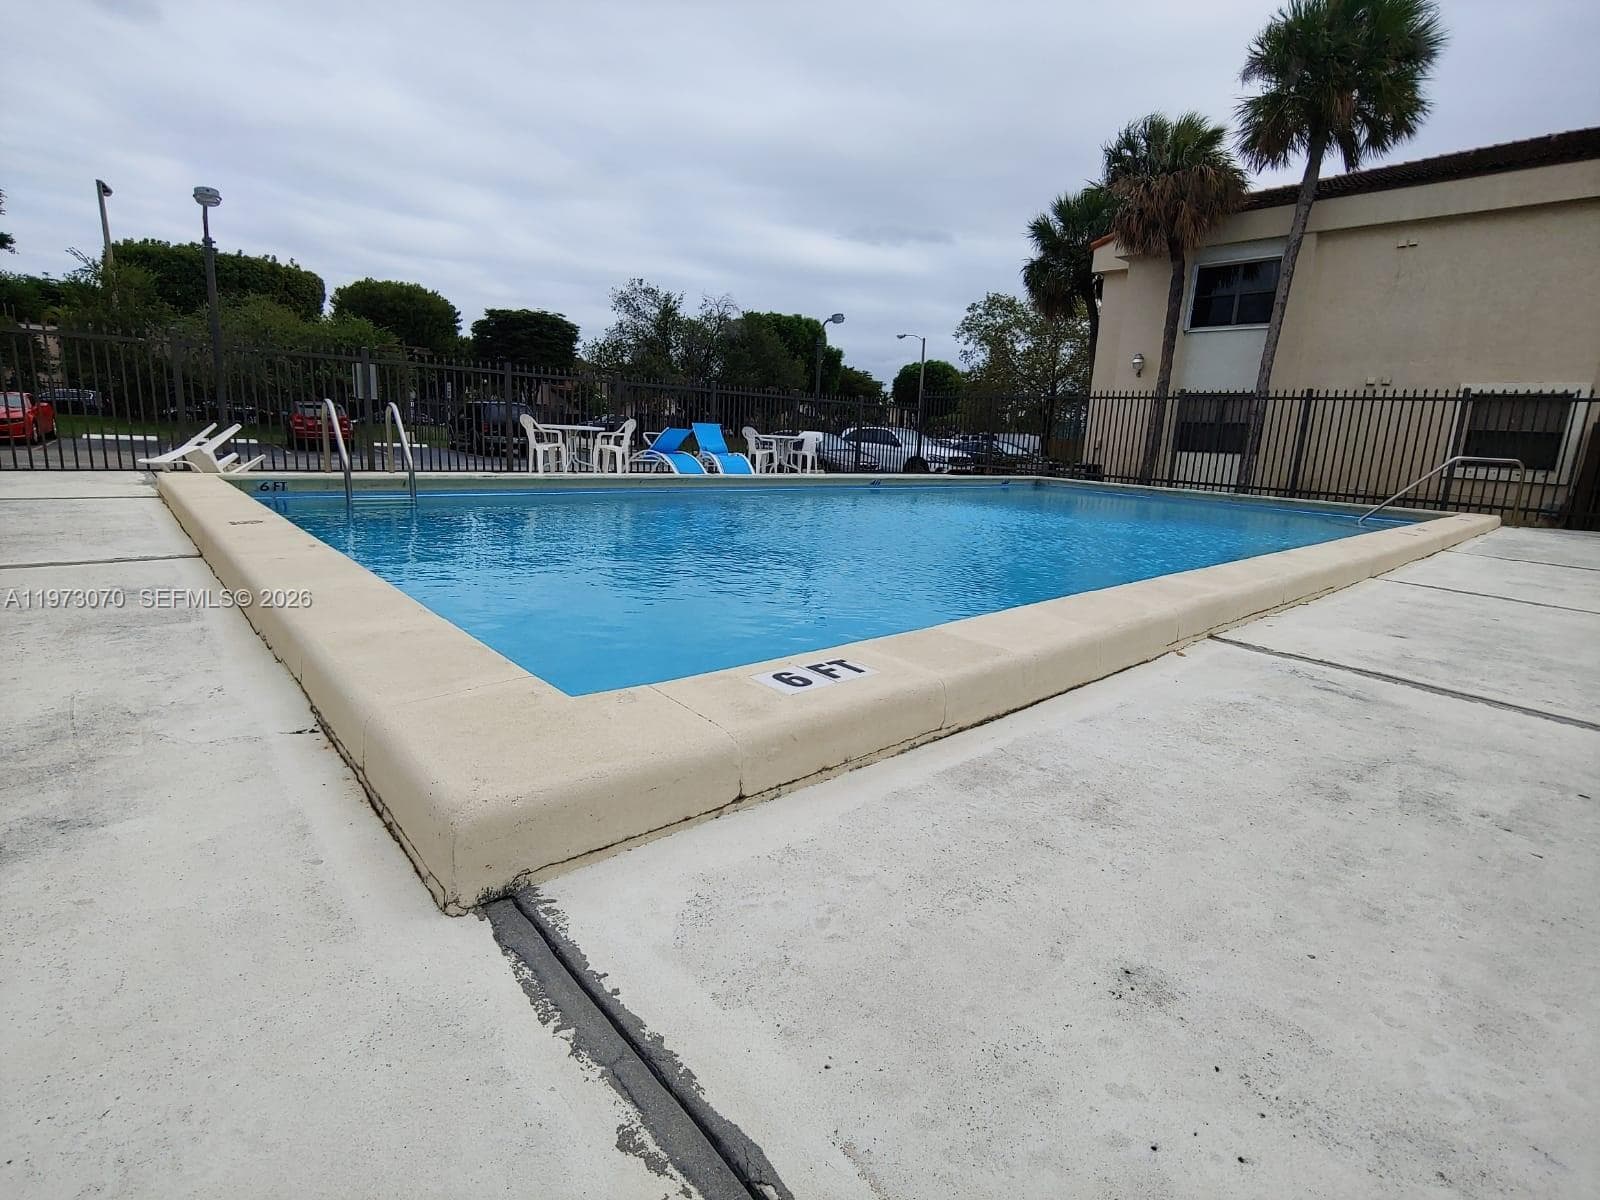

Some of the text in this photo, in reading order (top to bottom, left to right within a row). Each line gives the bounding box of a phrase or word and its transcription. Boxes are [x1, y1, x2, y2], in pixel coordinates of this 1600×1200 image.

[260, 481, 288, 491] 6 FT
[772, 659, 866, 687] 6 FT
